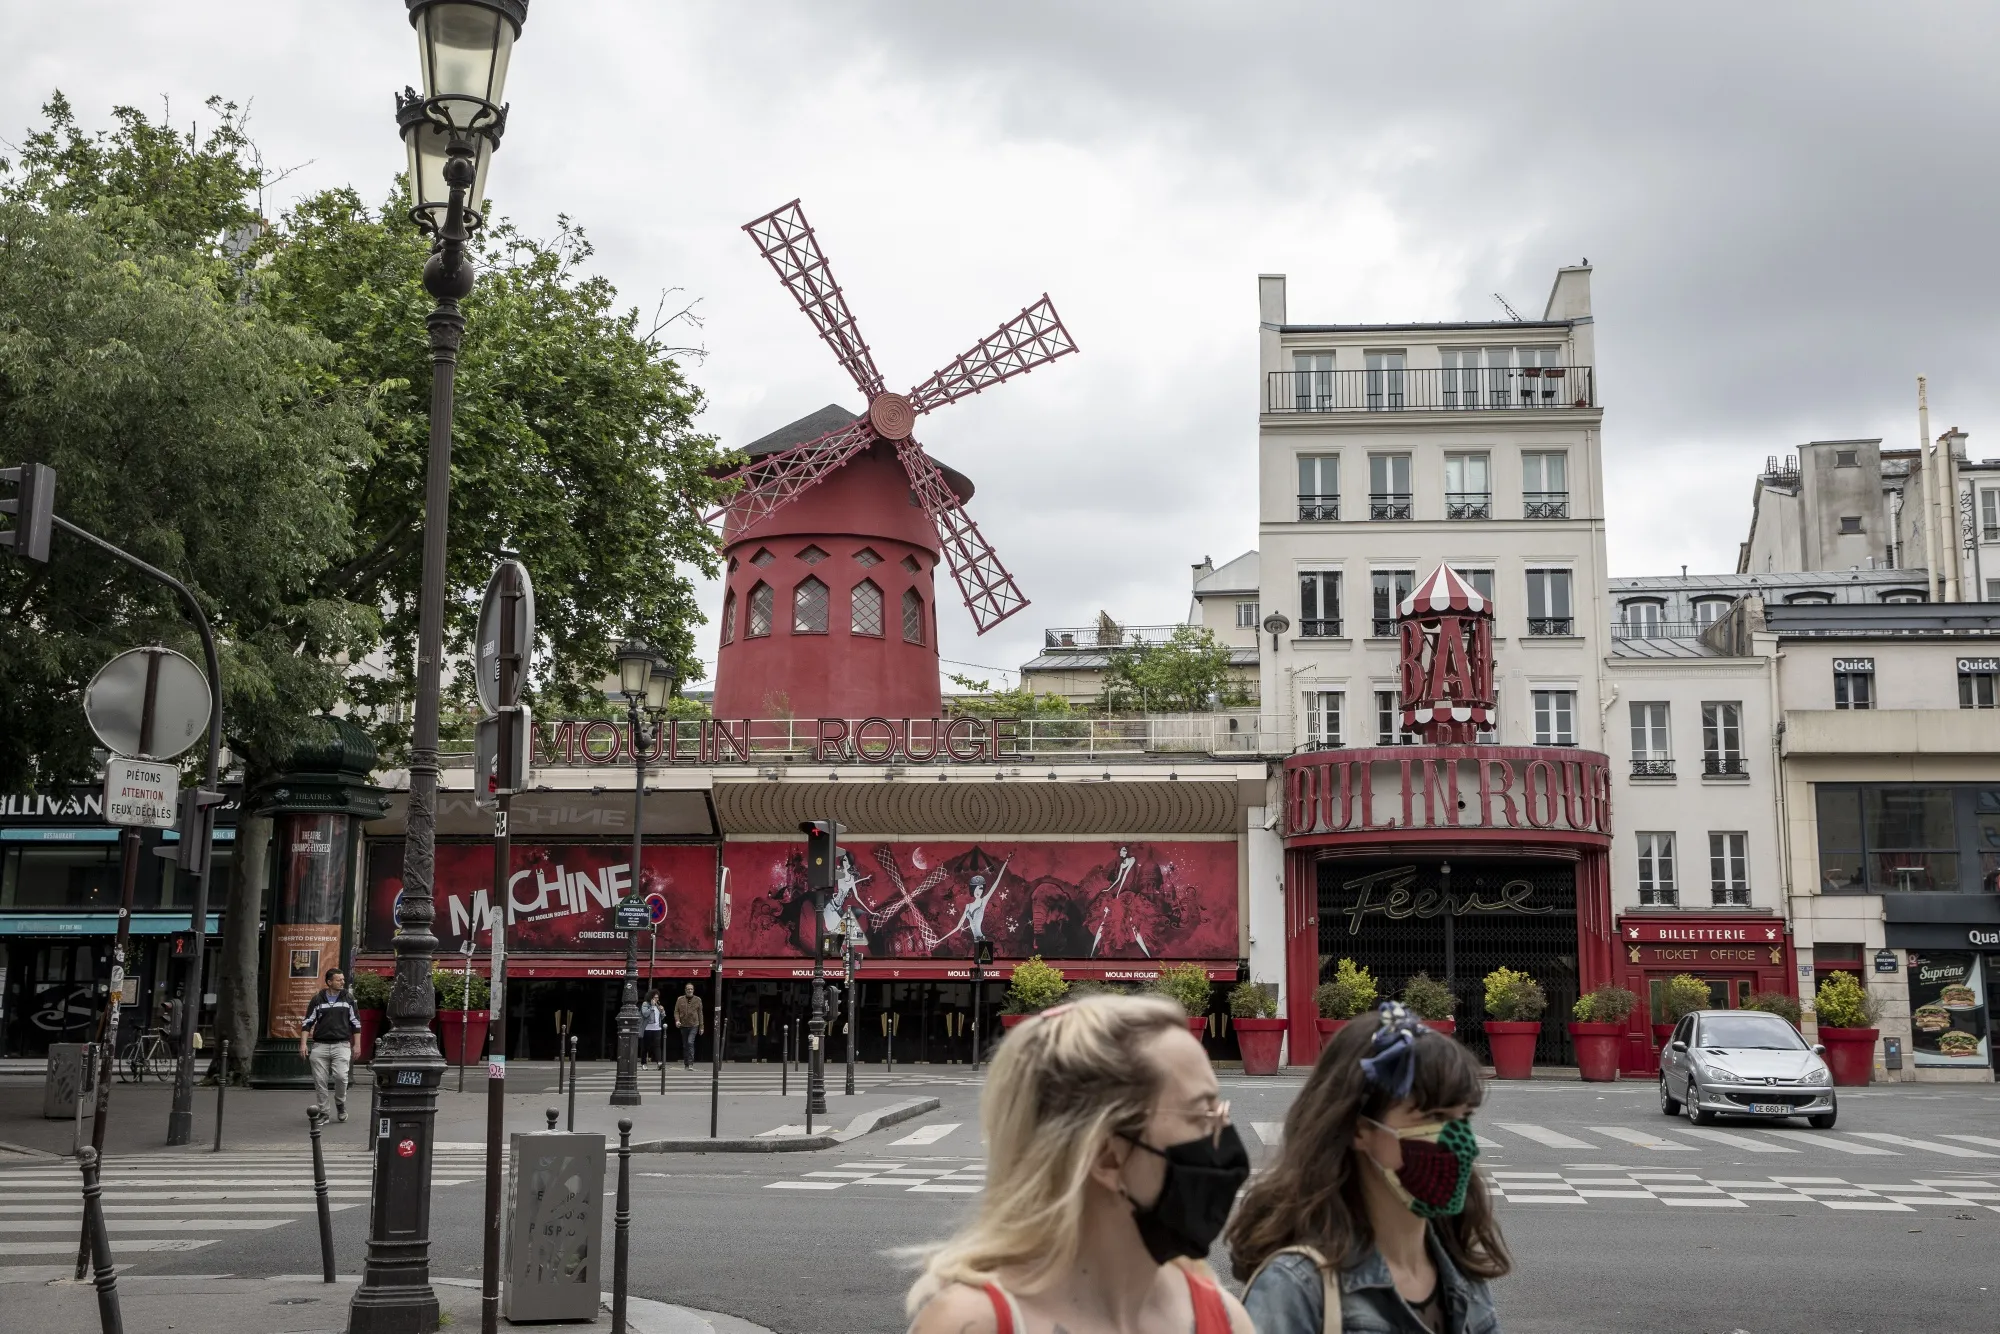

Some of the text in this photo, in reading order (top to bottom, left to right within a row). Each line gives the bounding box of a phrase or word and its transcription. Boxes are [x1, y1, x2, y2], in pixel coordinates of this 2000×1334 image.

[1834, 659, 1873, 672] Quick
[1958, 659, 1998, 672] Quick
[530, 717, 1021, 764] MOULIN ROUGE
[1437, 723, 1477, 745] DU
[126, 769, 161, 783] PIÉTONS
[122, 787, 164, 800] ATTENTION
[1285, 760, 1459, 832] OULIN
[111, 804, 171, 818] FEUX DÉCALÉS
[43, 832, 76, 840] RESTAURANT
[1343, 865, 1553, 935] Féerie
[535, 912, 554, 921] MOULIN
[554, 909, 570, 918] ROUGE
[578, 931, 615, 939] CONCERTS
[1659, 929, 1746, 940] BILLETTERIE
[1654, 949, 1756, 960] TICKET OFFICE
[1919, 965, 1964, 981] Suprême
